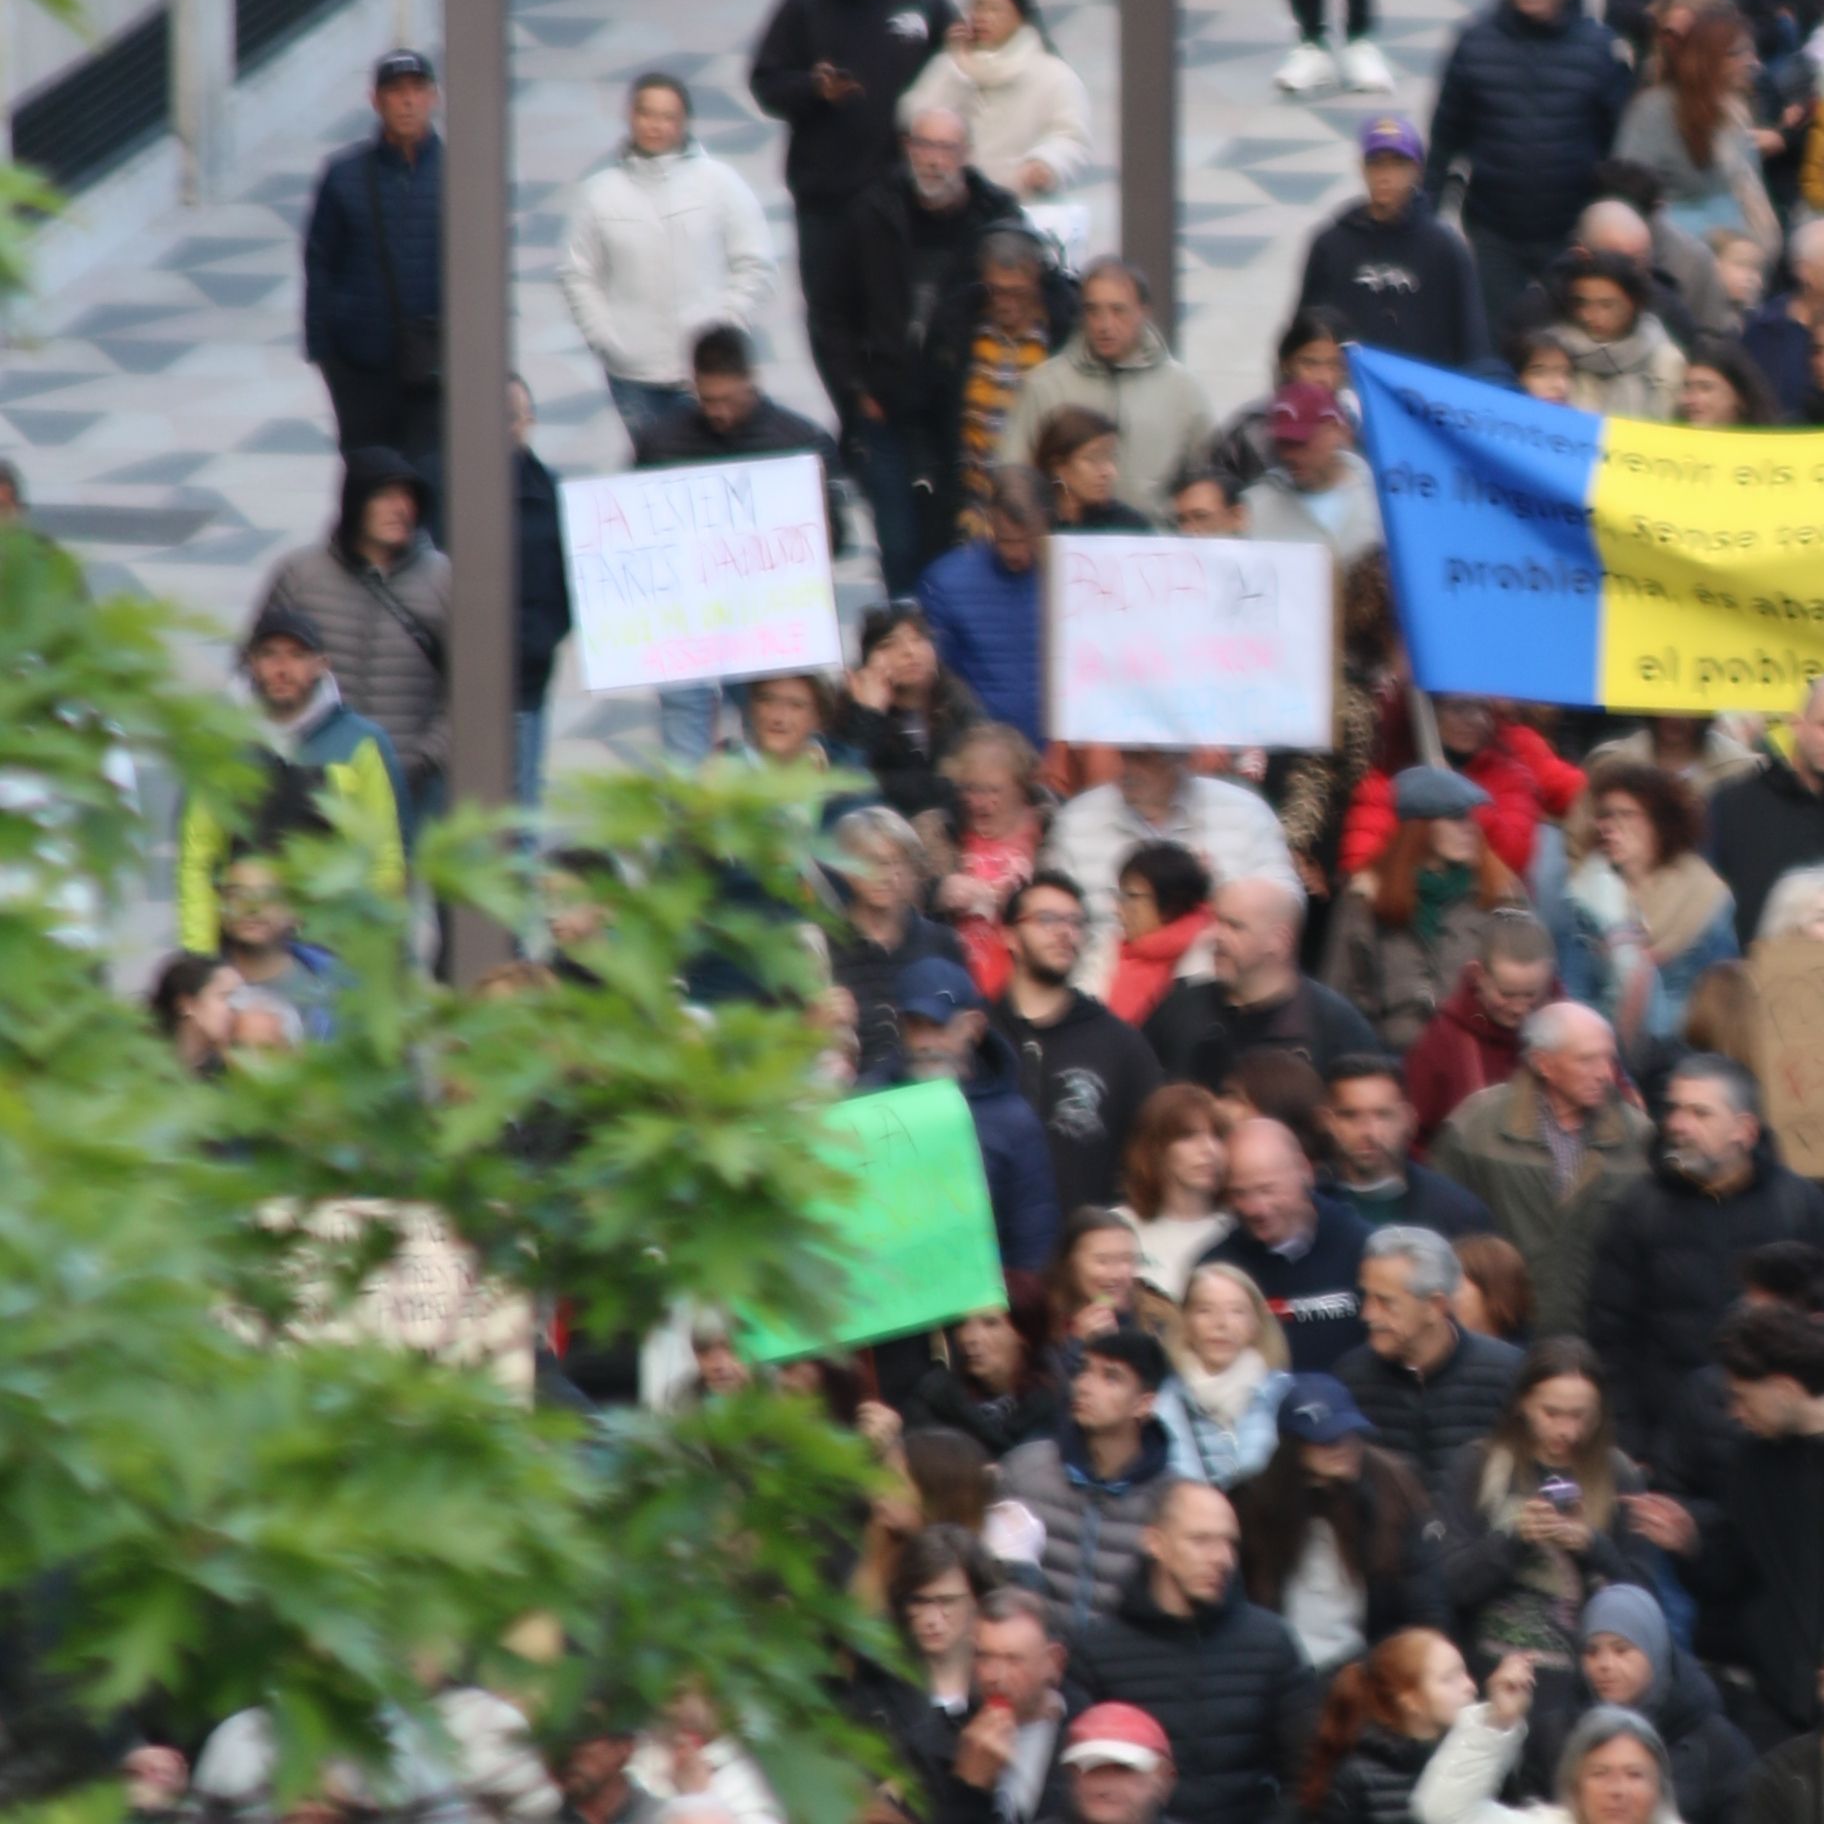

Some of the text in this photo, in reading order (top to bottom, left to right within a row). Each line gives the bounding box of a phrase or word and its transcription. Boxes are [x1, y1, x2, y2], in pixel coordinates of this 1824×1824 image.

[1733, 458, 1797, 488] els
[1384, 460, 1440, 500] de
[1630, 514, 1758, 551] sense
[1637, 650, 1681, 687] el
